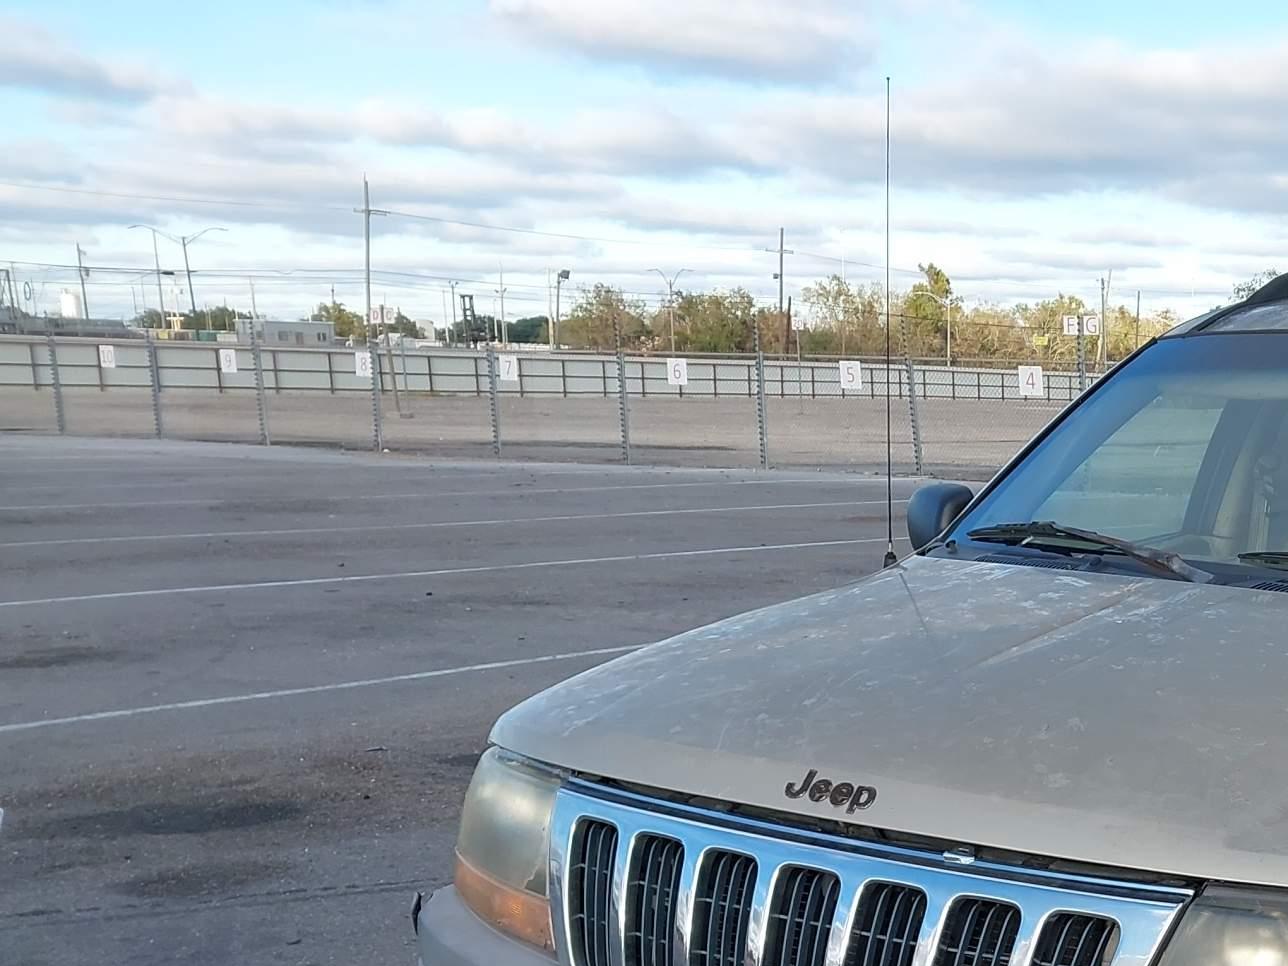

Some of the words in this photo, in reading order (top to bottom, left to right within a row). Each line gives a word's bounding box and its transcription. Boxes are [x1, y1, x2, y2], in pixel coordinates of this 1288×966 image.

[1067, 317, 1075, 334] F
[1086, 317, 1097, 334] G
[505, 360, 512, 376] 7
[673, 363, 681, 379] 6
[847, 367, 855, 382] 5
[1026, 371, 1035, 389] 4
[784, 768, 878, 815] Jeep
